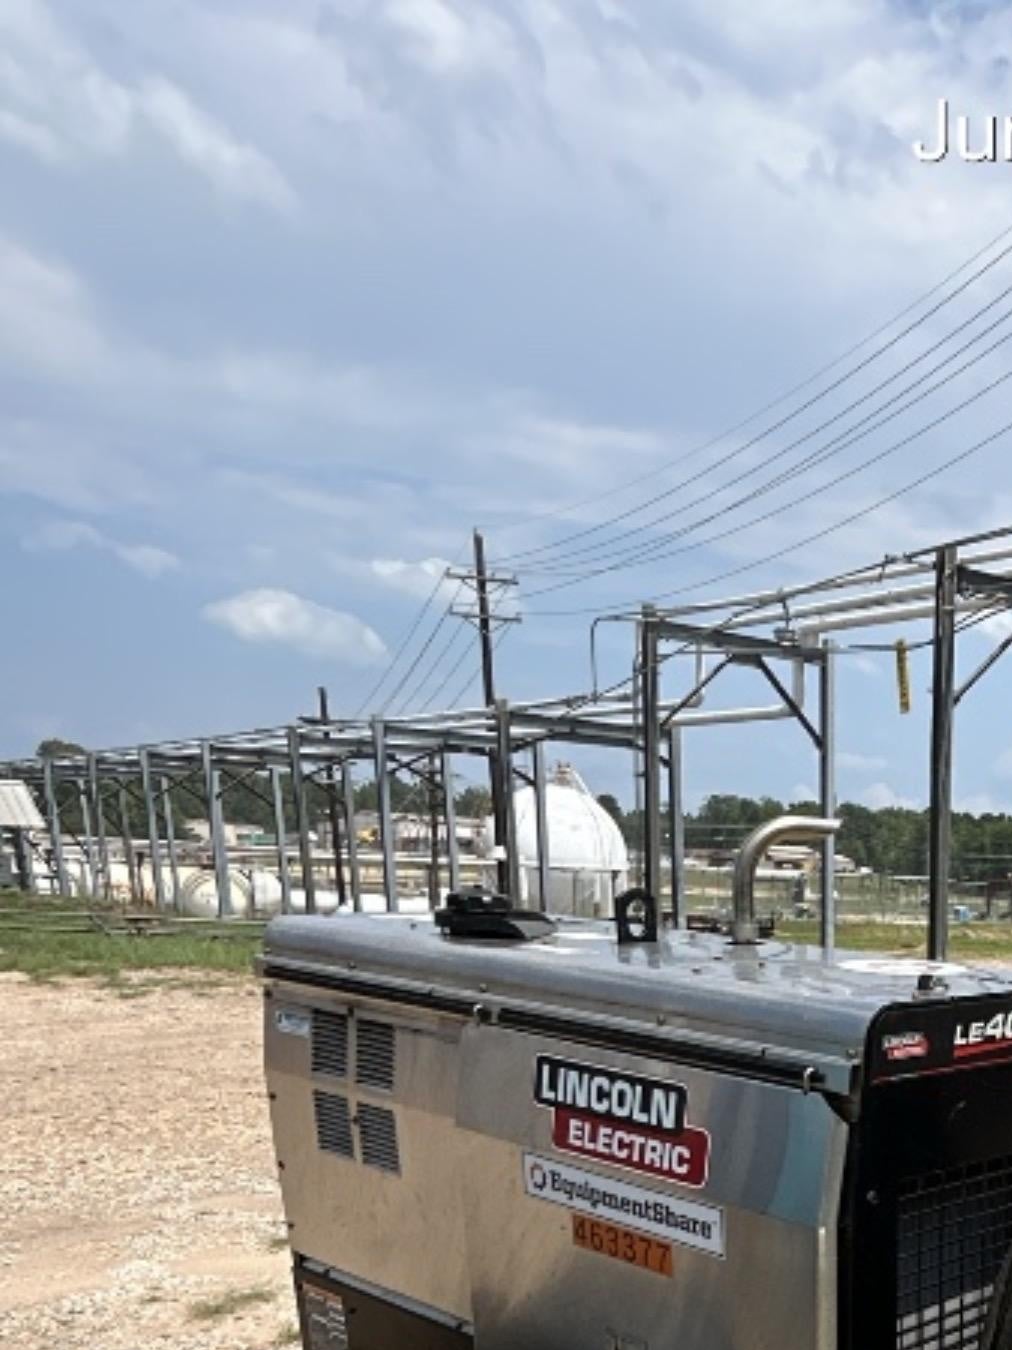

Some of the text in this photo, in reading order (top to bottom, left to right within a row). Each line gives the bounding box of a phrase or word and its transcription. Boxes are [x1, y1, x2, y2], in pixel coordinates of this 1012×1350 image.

[541, 1063, 679, 1129] LINCOLN
[567, 1118, 691, 1175] ELECTRIC
[550, 1169, 712, 1240] EquipmentShare
[574, 1217, 671, 1273] 463377
